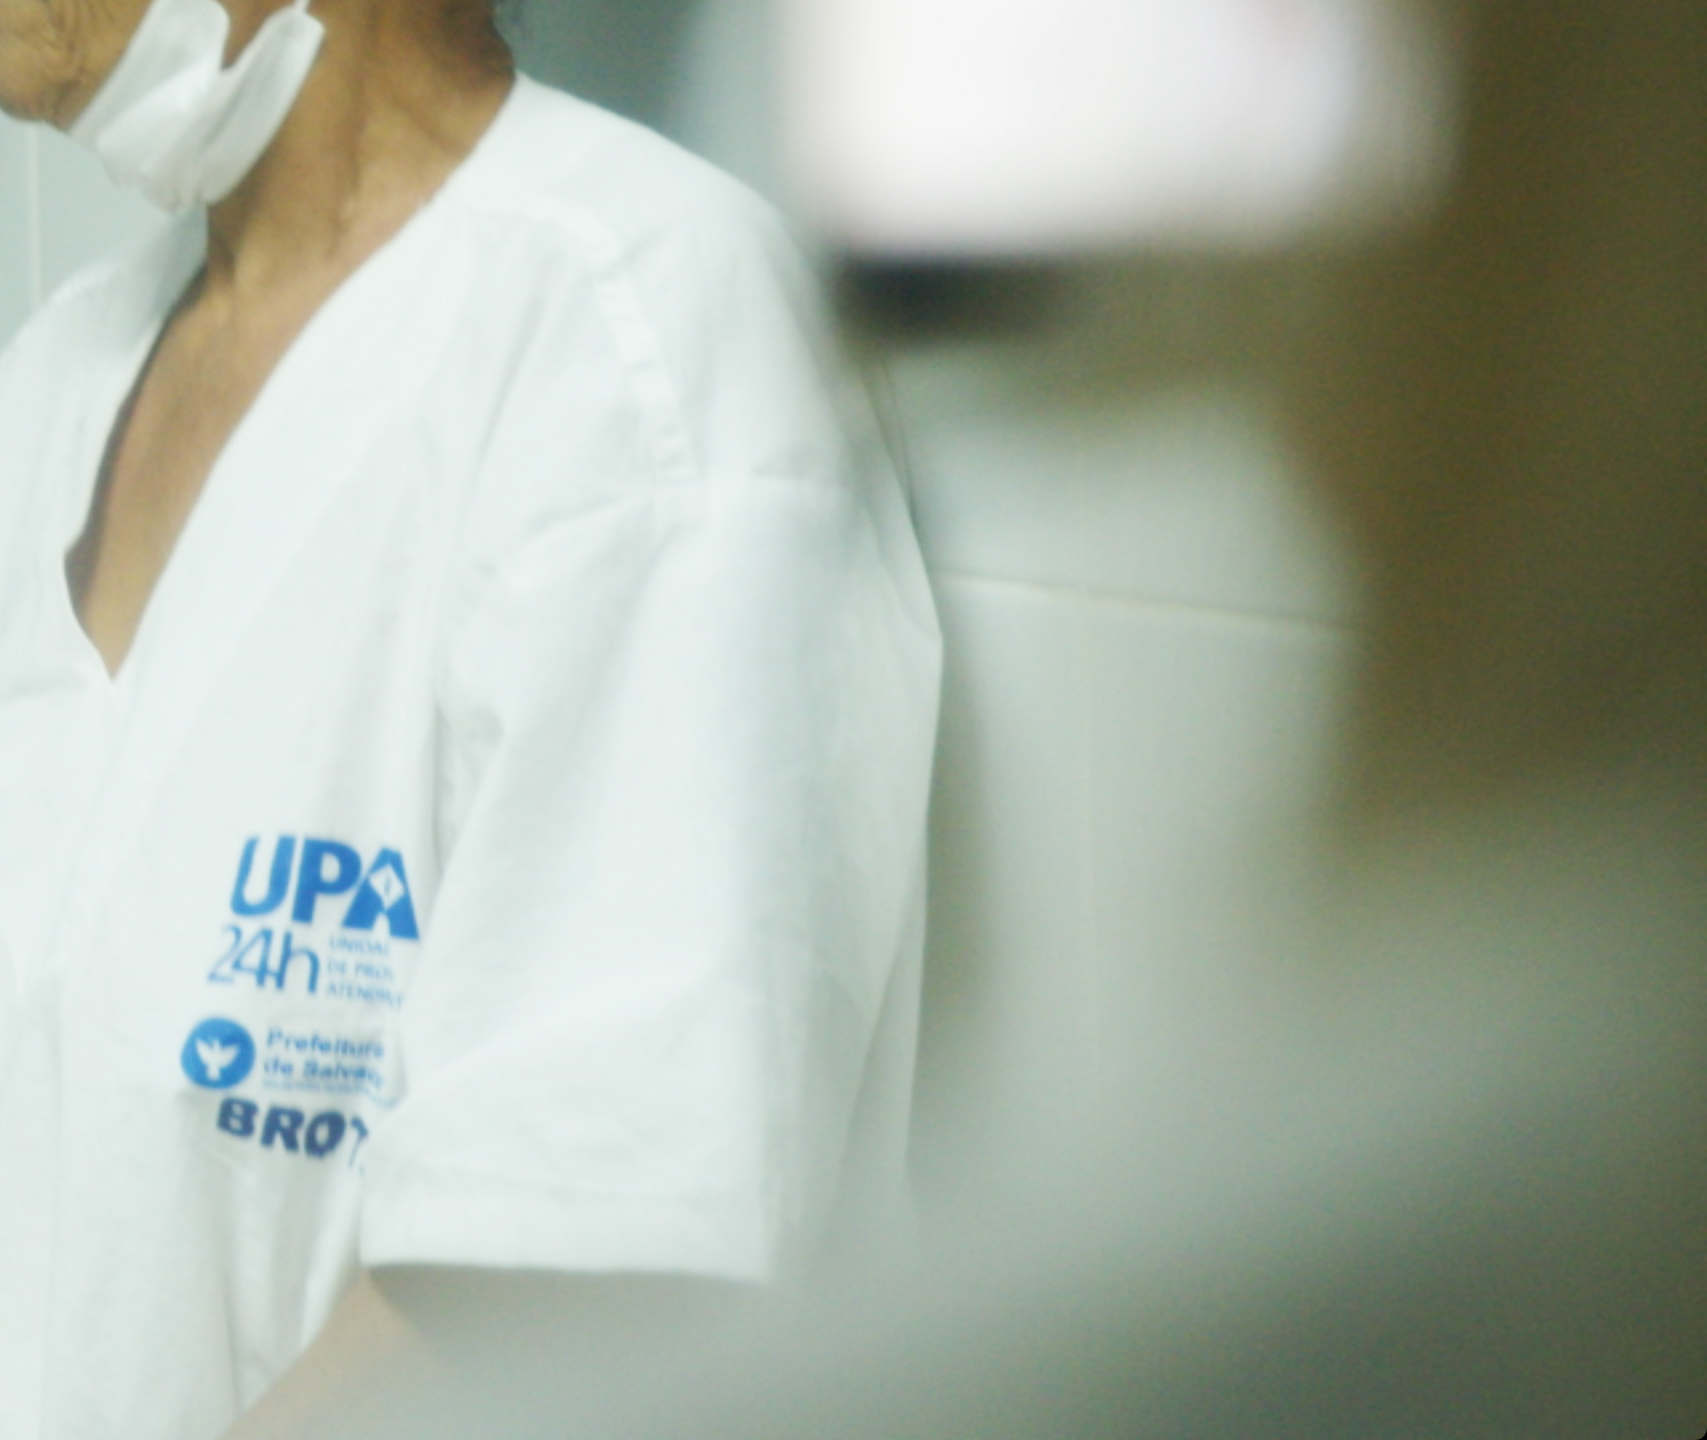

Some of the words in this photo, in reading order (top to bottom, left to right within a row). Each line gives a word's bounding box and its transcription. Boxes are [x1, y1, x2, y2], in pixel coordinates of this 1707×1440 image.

[230, 833, 420, 941] UPA
[206, 922, 321, 995] 24h
[263, 1056, 295, 1076] de
[266, 1028, 386, 1059] Prefeitura
